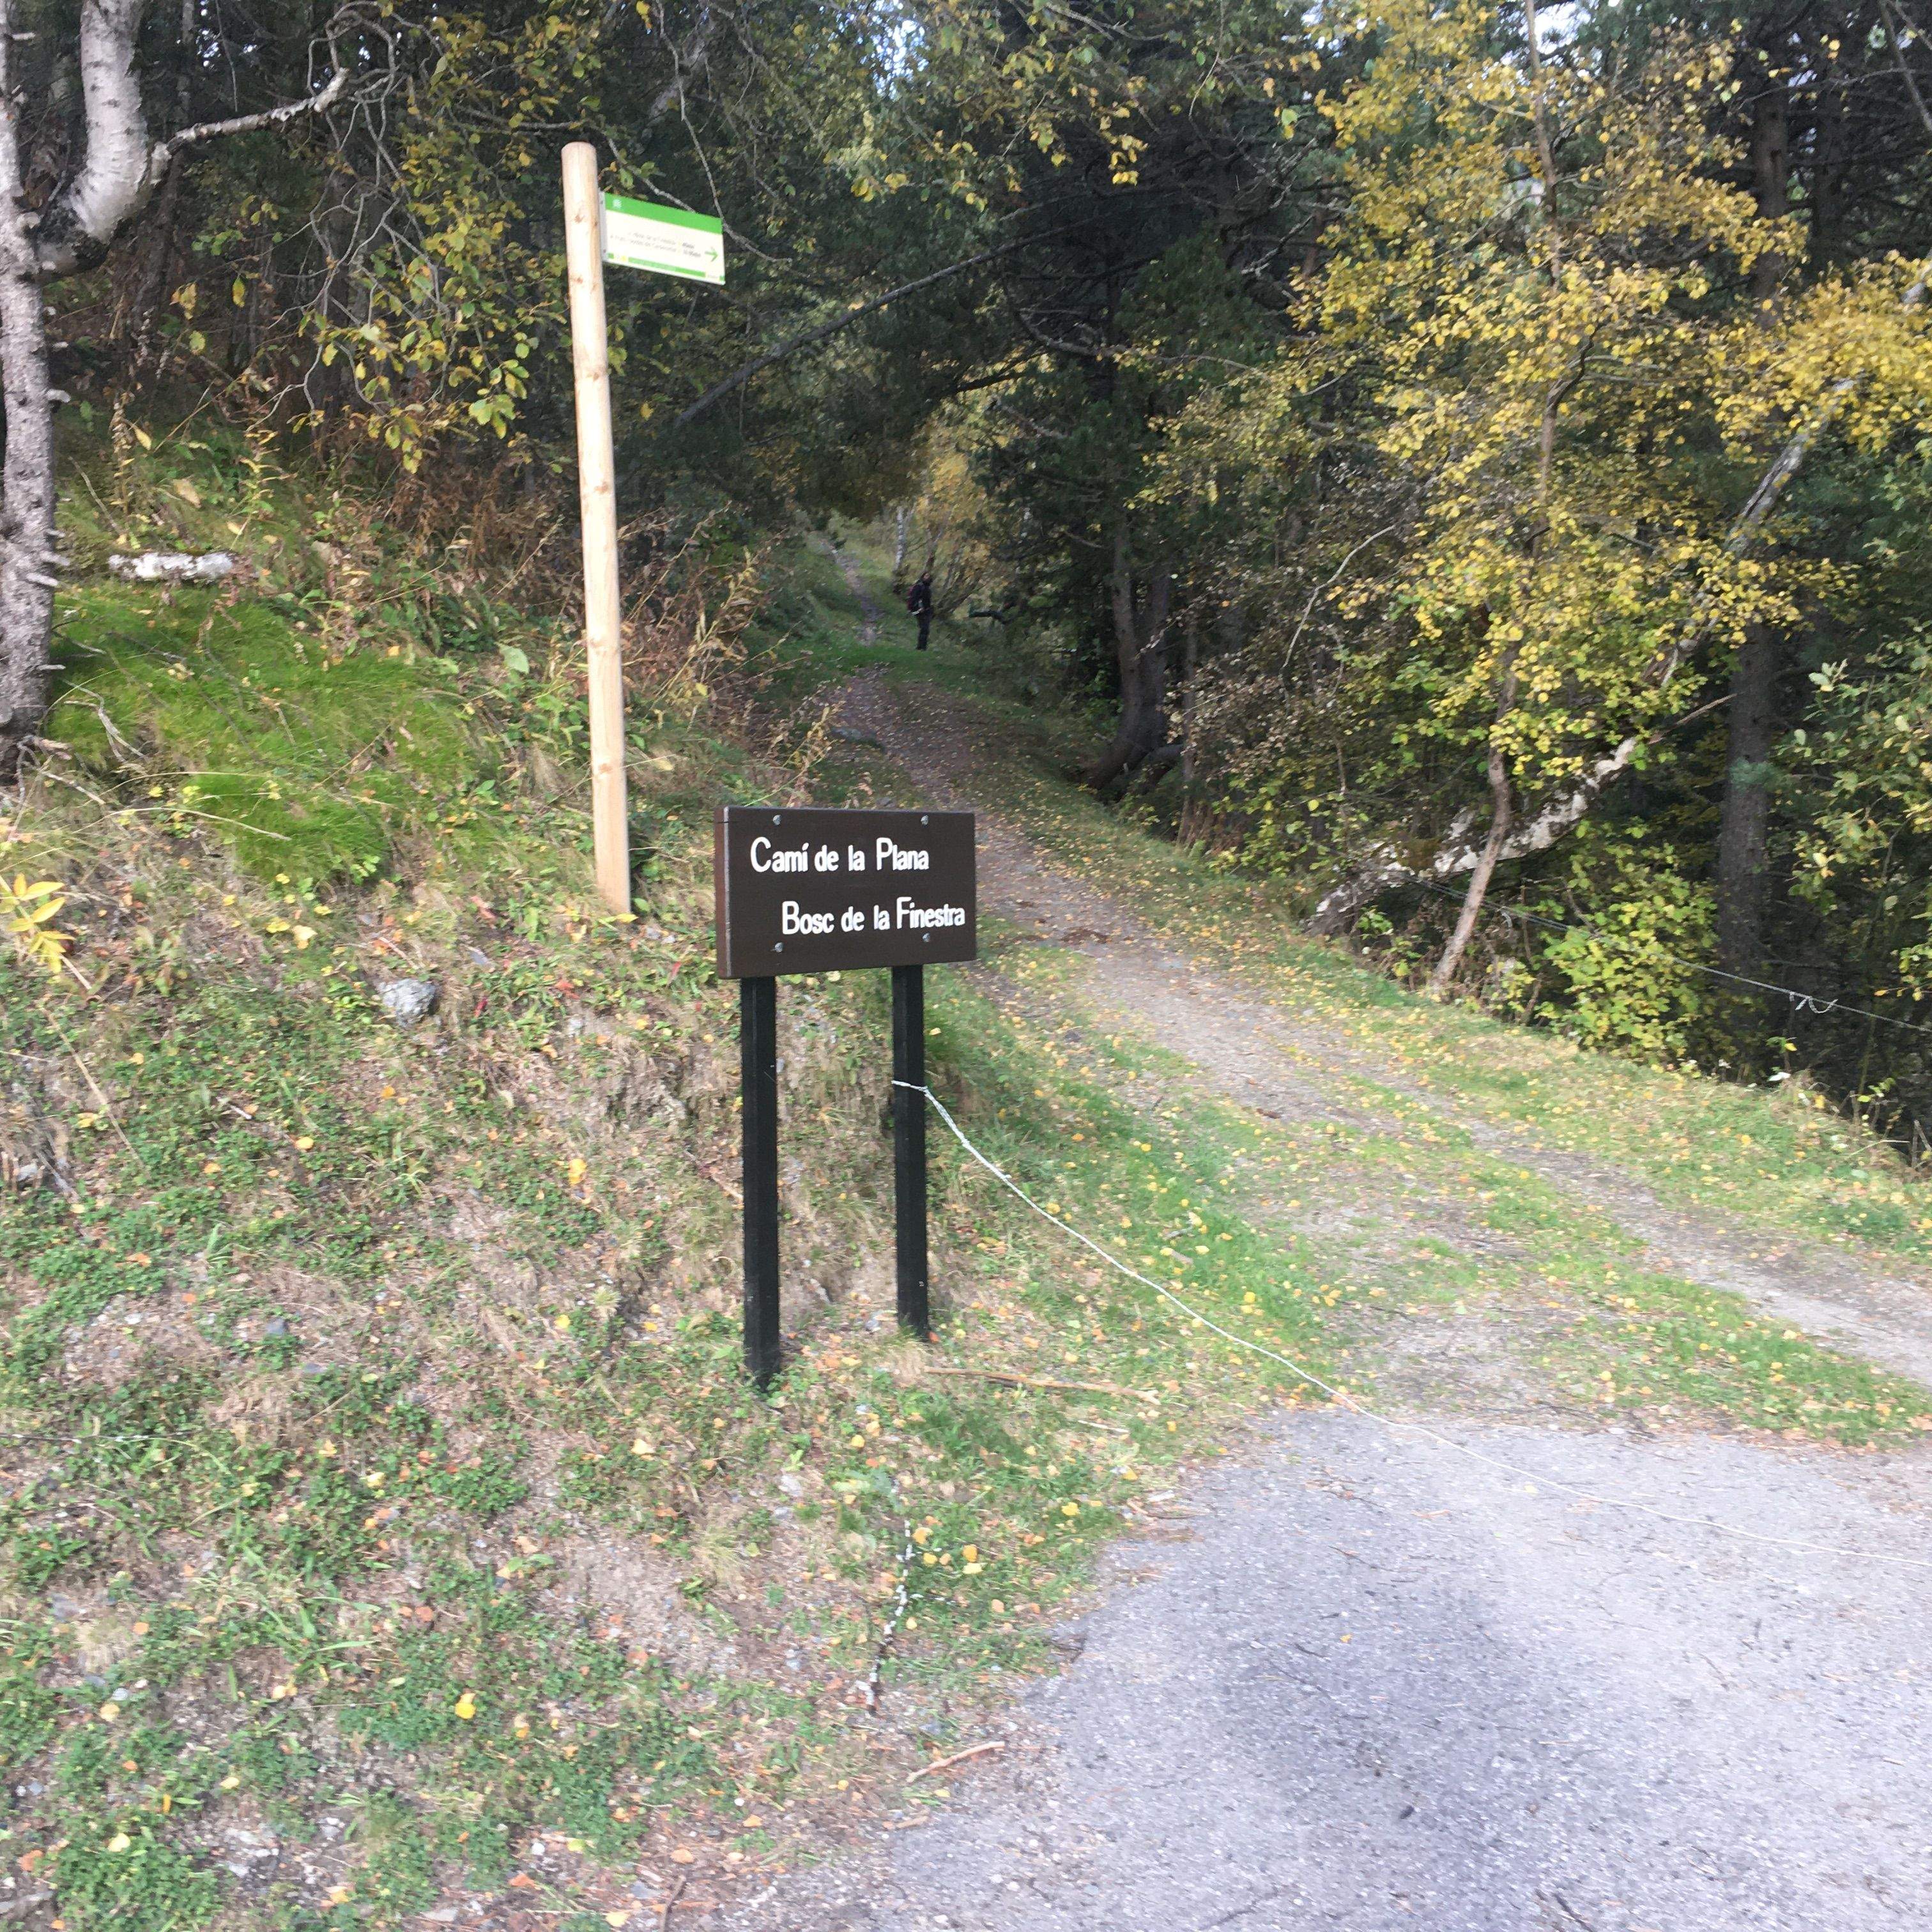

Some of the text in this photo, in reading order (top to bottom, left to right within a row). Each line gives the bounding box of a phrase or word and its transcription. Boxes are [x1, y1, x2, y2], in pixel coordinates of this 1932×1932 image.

[750, 836, 930, 873] Camí de la Plana
[781, 896, 965, 935] Bosc de la Finestra
